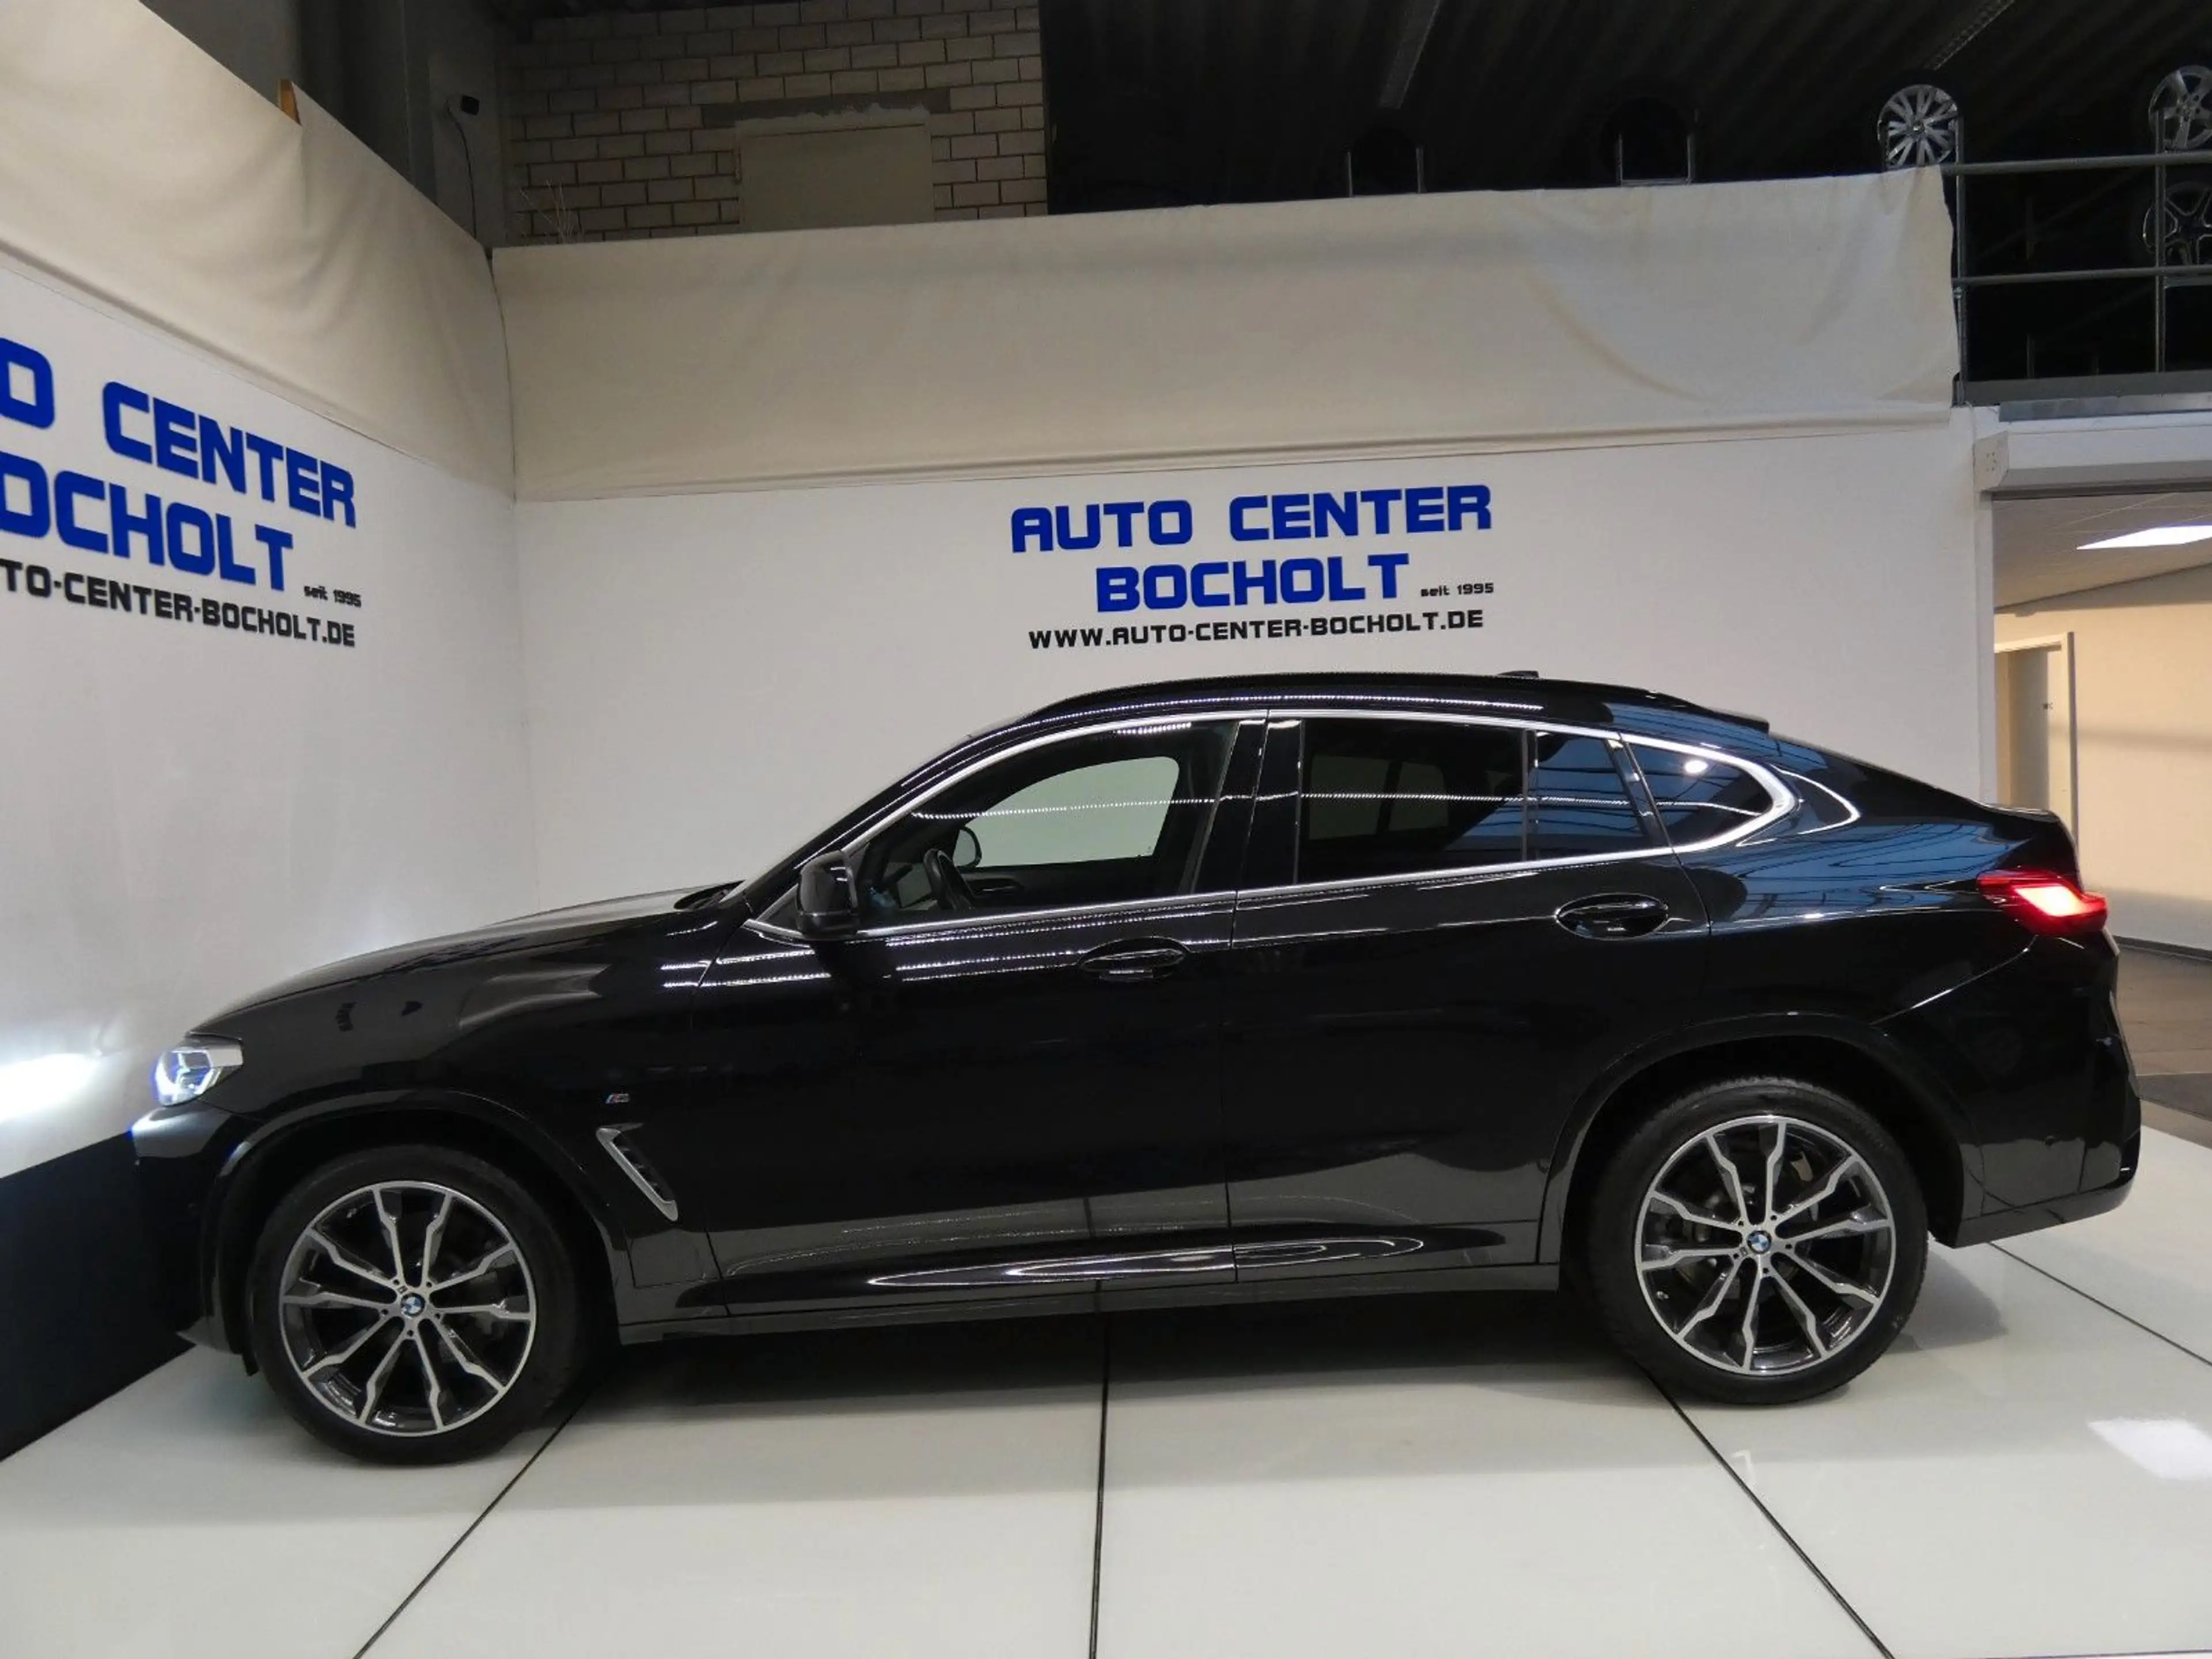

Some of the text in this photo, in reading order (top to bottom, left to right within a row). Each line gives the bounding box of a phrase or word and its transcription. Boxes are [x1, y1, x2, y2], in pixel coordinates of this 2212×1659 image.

[103, 381, 356, 528] CENTER
[0, 451, 293, 591] OCHOLT
[333, 589, 362, 608] 1995
[1011, 484, 1492, 554] AUTO CENTER
[1096, 552, 1494, 613] BOCHOLT seit 1995
[1028, 609, 1484, 649] WWW.AUTO-CENTER-BOCHOLT.DE
